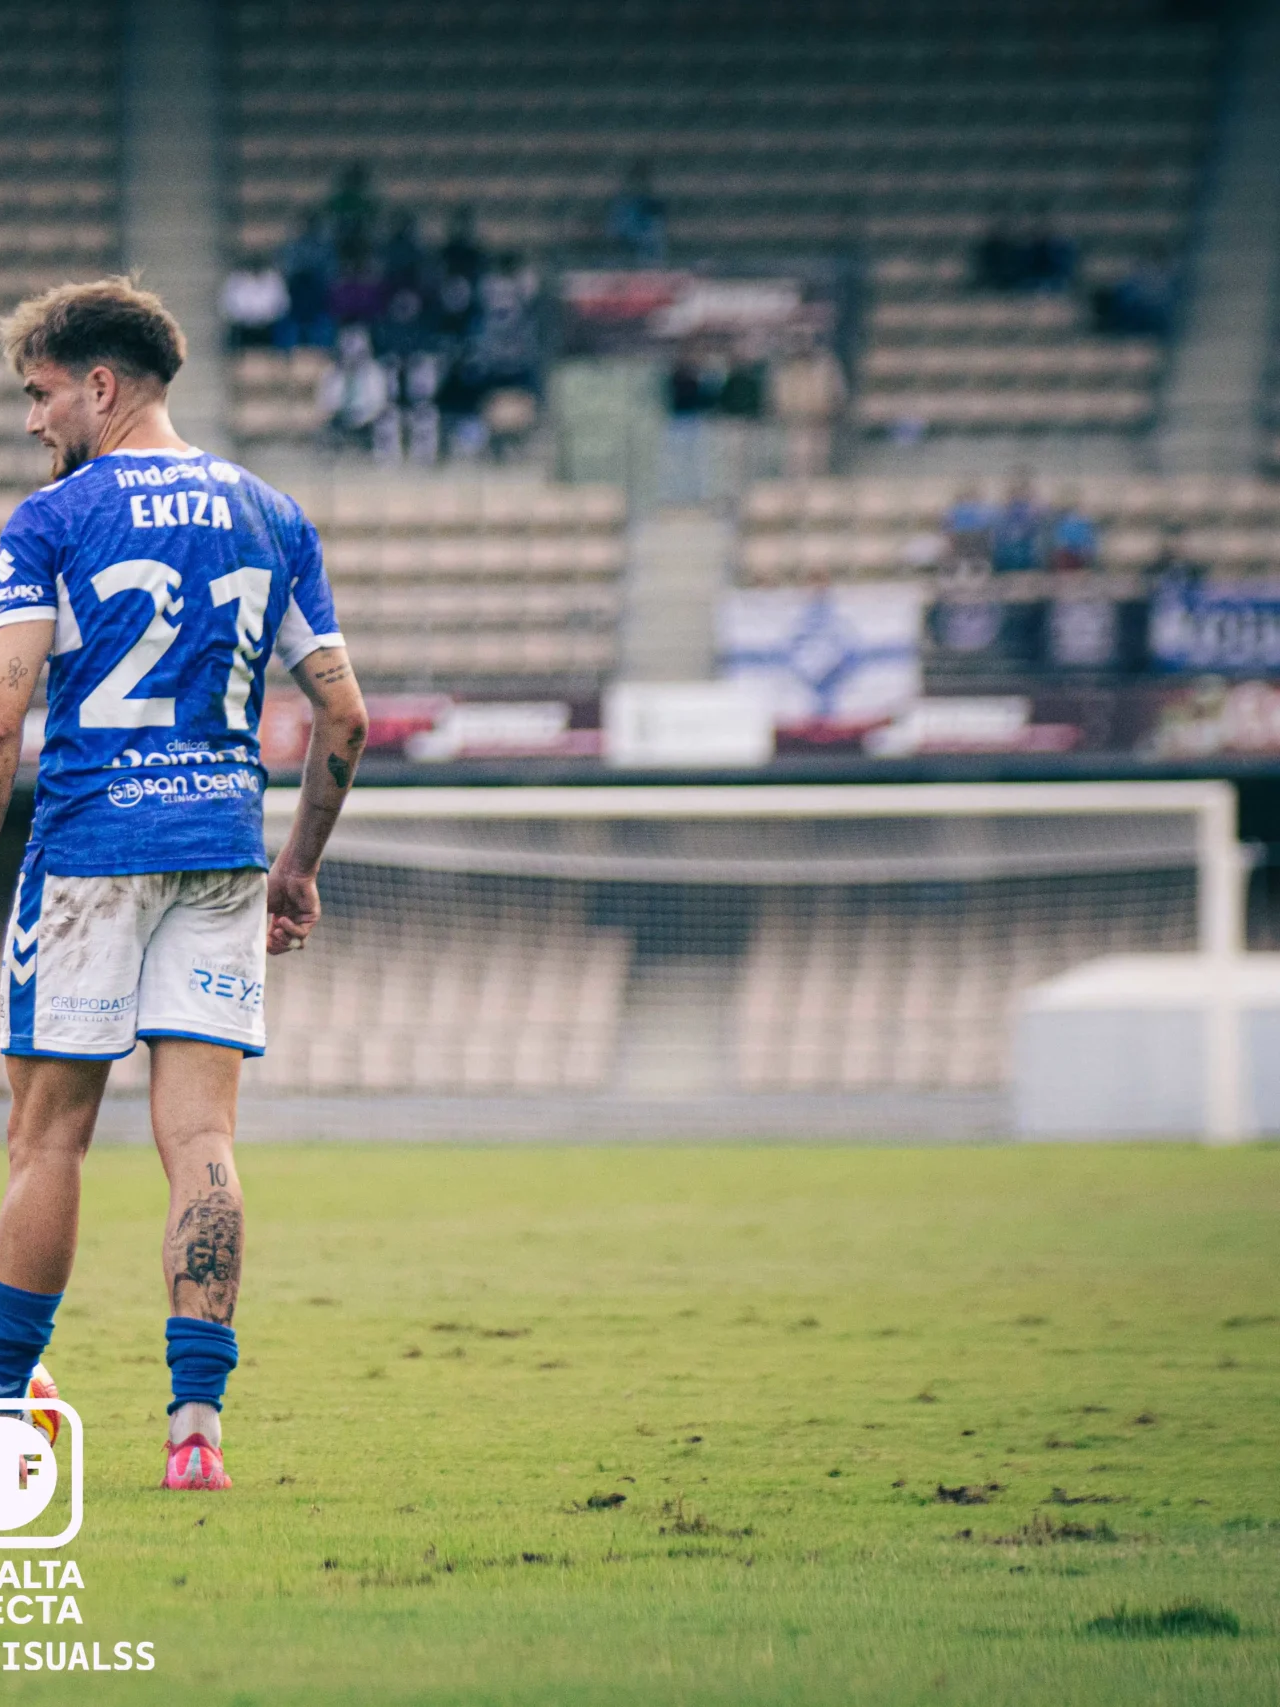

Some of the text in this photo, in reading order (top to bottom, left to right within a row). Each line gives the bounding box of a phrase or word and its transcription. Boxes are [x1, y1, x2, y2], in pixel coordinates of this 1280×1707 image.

[129, 490, 233, 530] EKIZA
[79, 558, 272, 731] 21
[142, 776, 188, 795] san
[206, 1162, 228, 1187] 10
